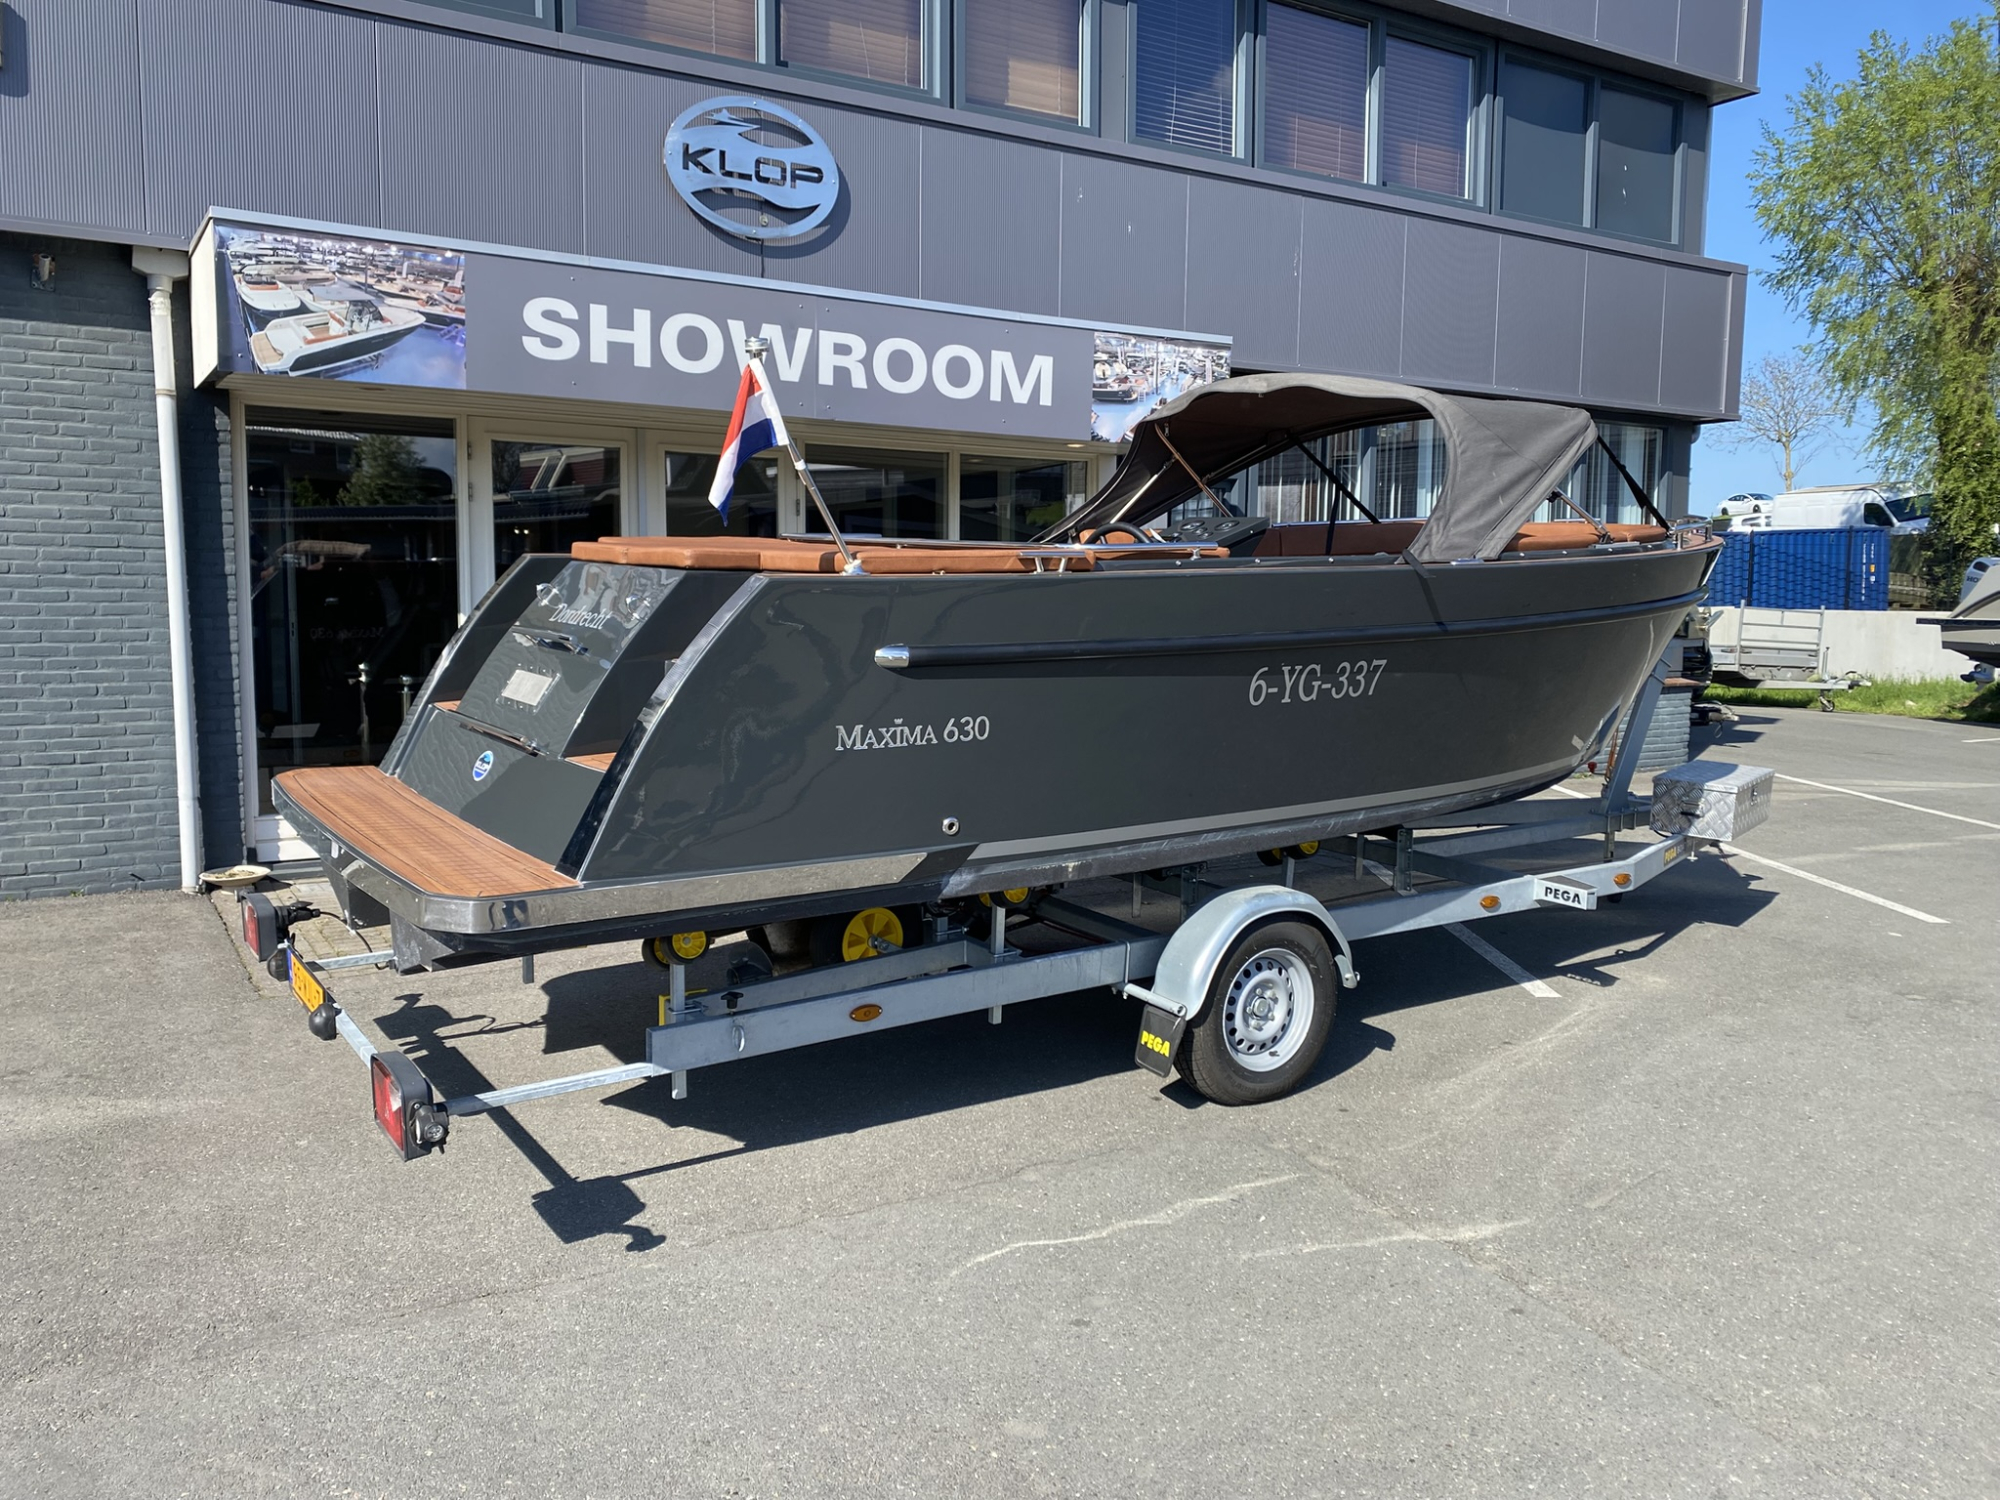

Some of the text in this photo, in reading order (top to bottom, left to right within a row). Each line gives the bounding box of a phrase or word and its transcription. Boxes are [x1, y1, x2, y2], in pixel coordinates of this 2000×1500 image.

[682, 142, 824, 189] KLOP
[521, 296, 1054, 407] SHOWROOM
[549, 603, 613, 629] Dordrecht
[1249, 659, 1387, 706] 6-YG-337
[942, 715, 990, 743] 630
[1544, 886, 1582, 905] PEGA
[1140, 1030, 1171, 1058] PEGA
